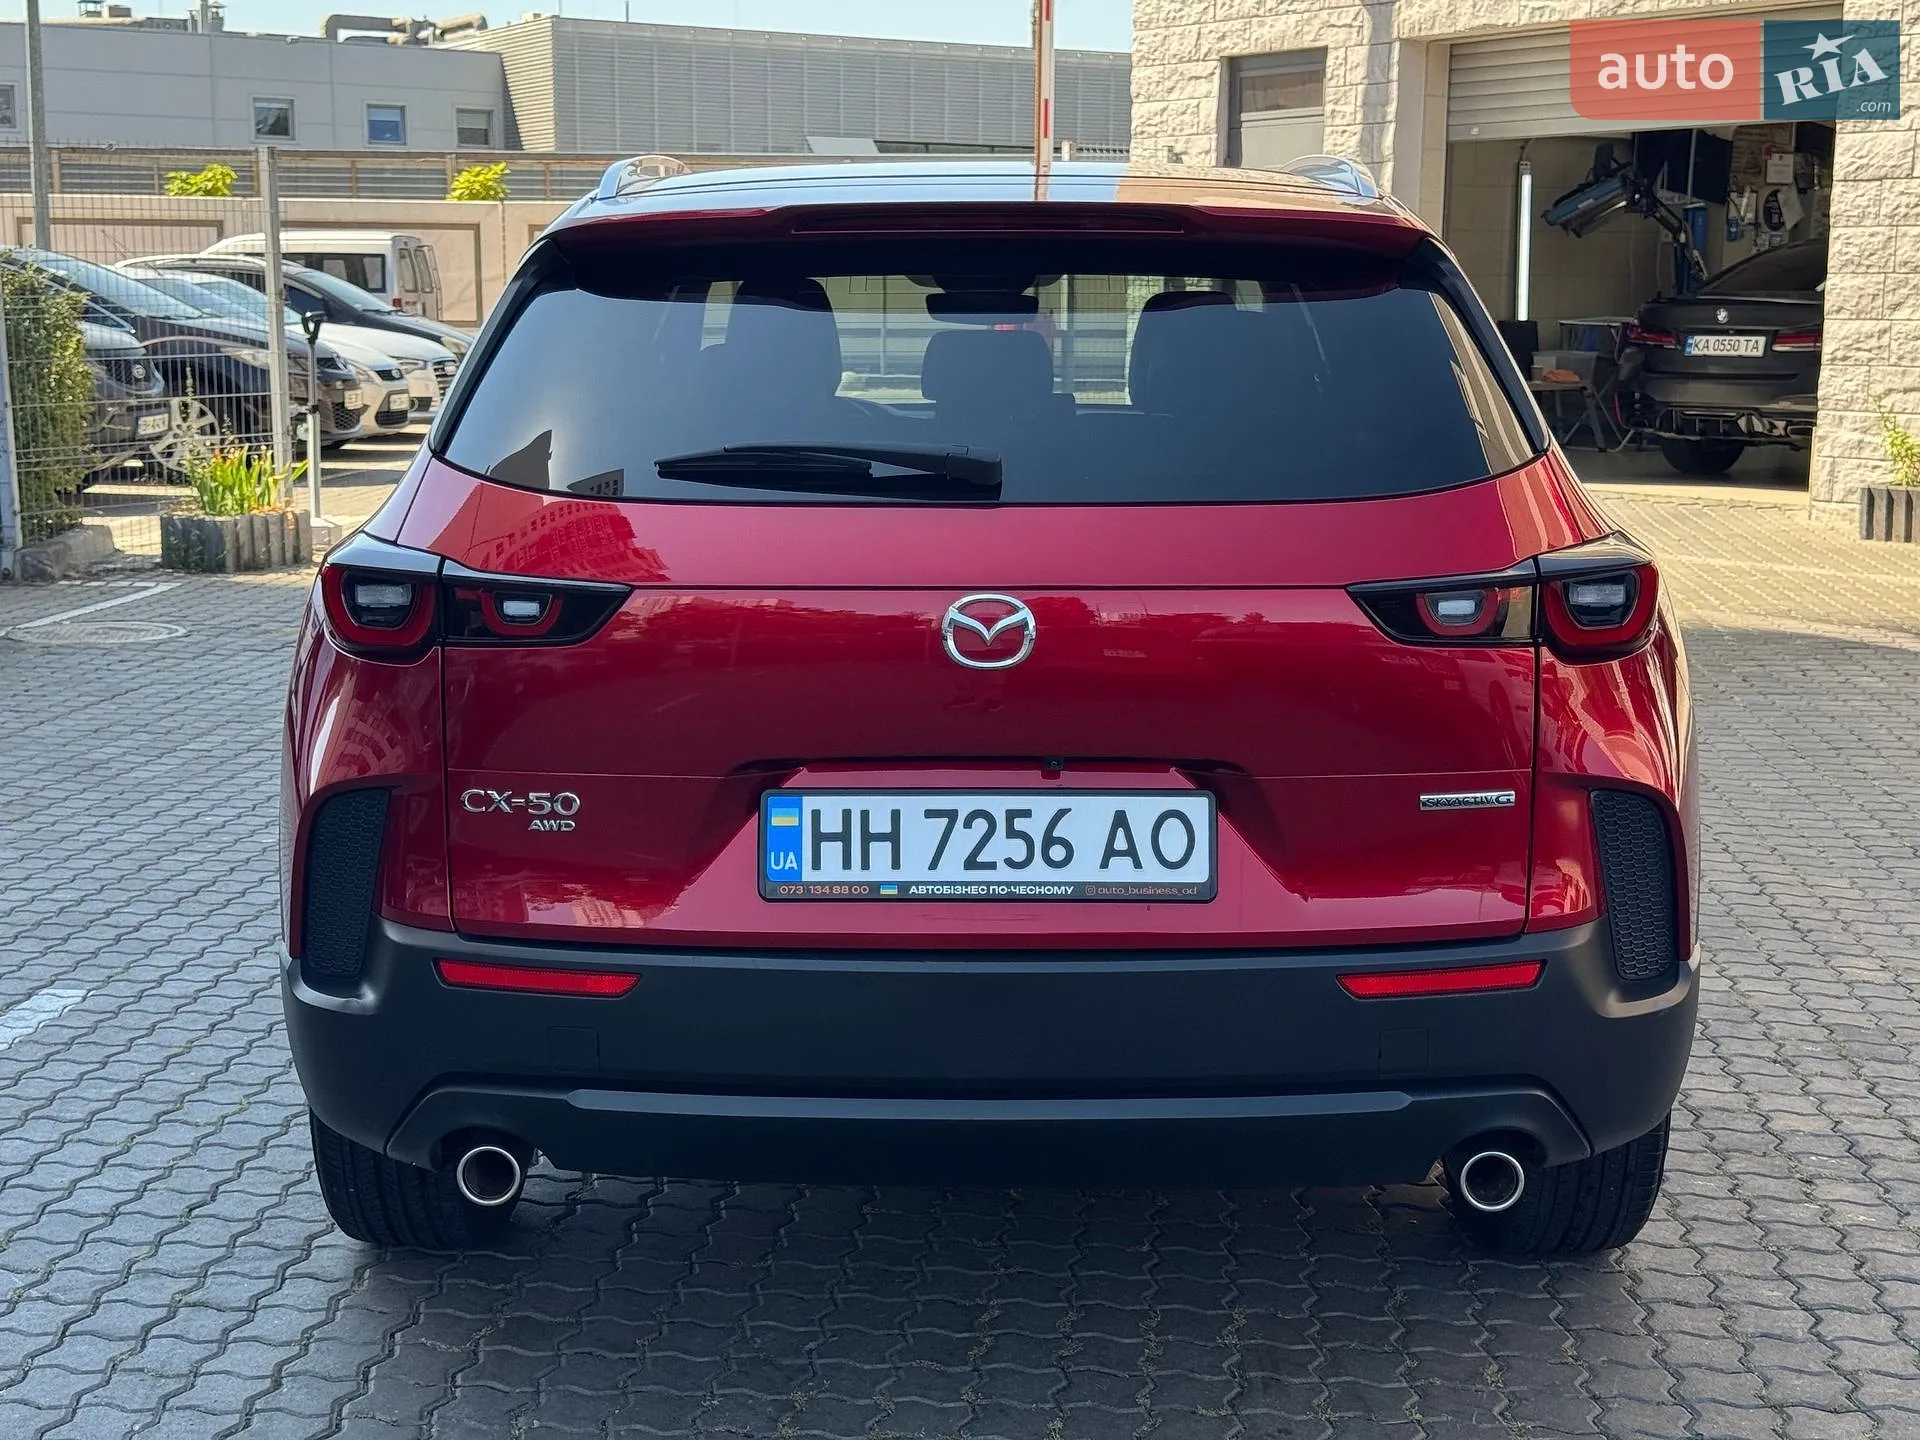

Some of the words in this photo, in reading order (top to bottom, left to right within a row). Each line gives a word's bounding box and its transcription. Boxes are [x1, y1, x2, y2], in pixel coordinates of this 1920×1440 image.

[460, 789, 581, 816] CX-50
[528, 819, 576, 831] AWD
[810, 808, 902, 871] HH
[923, 808, 1075, 871] 7256
[770, 852, 799, 871] UA
[779, 885, 804, 895] 073
[809, 885, 830, 895] 134
[832, 885, 849, 895] 88
[851, 885, 870, 895] 00
[909, 885, 987, 895] АВТОБІЗНЕС
[1097, 885, 1198, 896] auto_business_od
